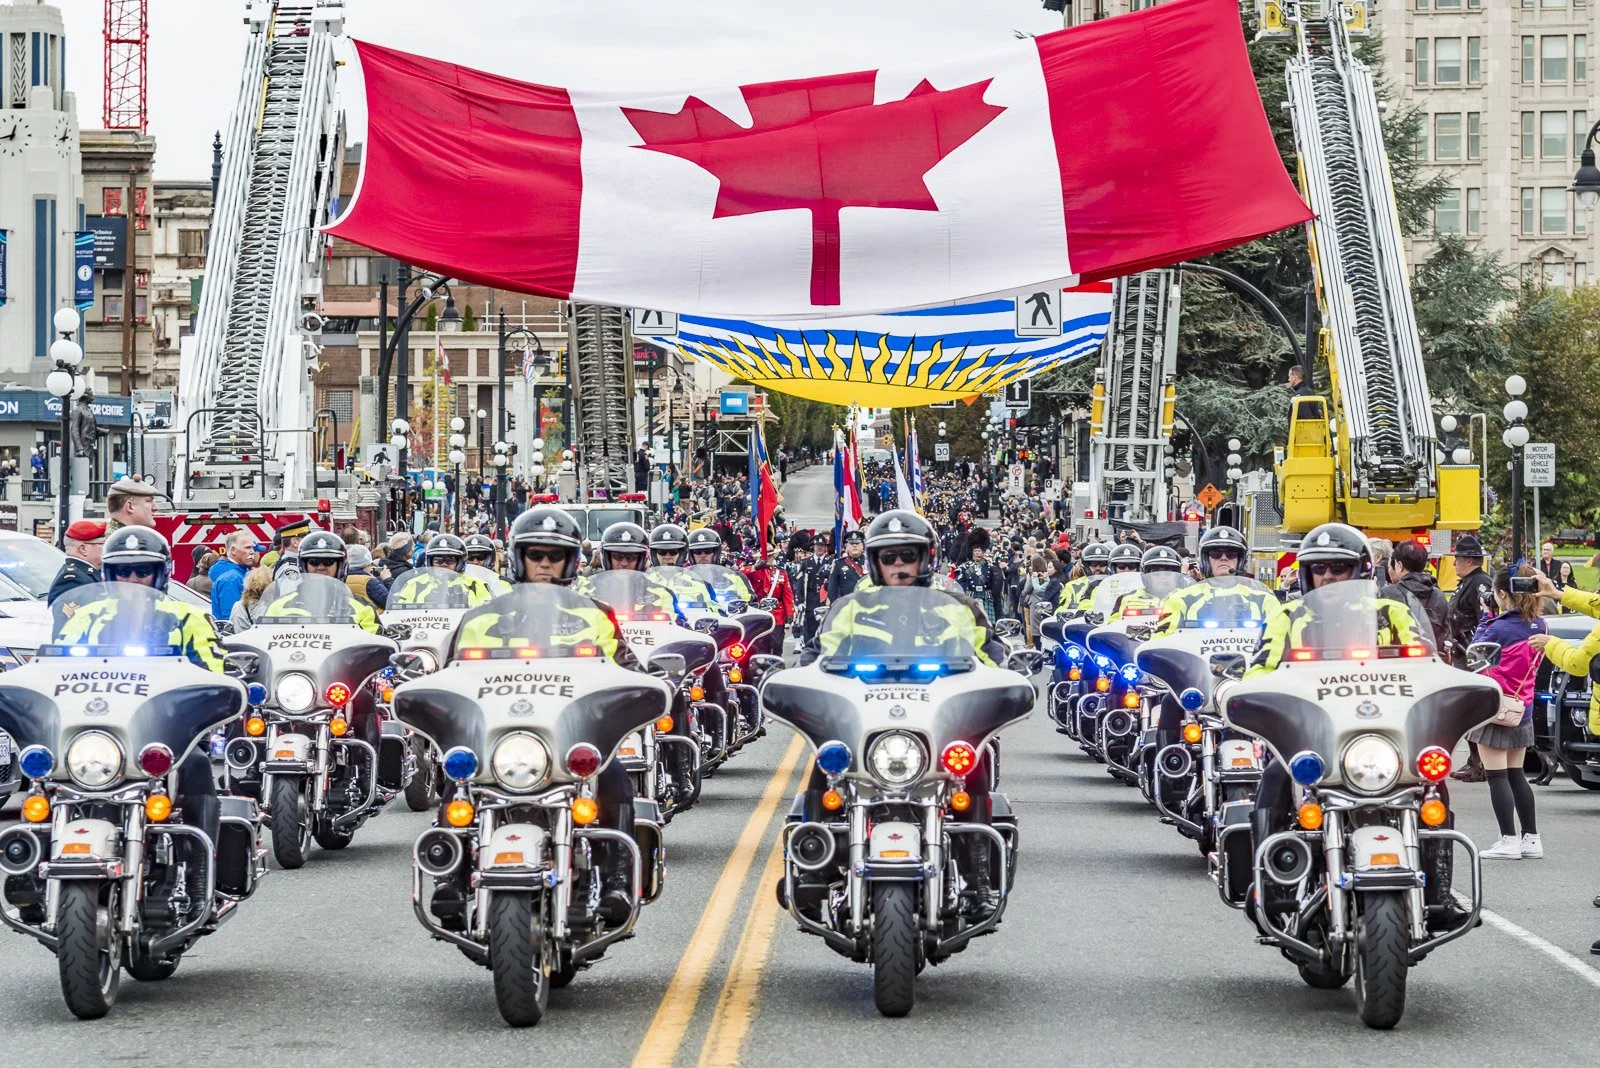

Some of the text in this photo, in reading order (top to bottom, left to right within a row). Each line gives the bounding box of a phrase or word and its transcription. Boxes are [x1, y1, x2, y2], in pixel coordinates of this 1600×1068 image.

[102, 404, 124, 416] CENTRE
[936, 447, 949, 456] 30
[410, 622, 451, 630] OLICE
[272, 632, 331, 641] VANCOUVER
[1202, 637, 1256, 645] VANCOUVE
[267, 640, 333, 651] POLICE
[1200, 645, 1254, 655] POLIC
[61, 671, 147, 681] VANCOUVER
[484, 673, 571, 684] VANCOUVER
[1319, 673, 1407, 685] VANCOUVER
[54, 682, 149, 697] POLICE
[477, 684, 575, 699] POLICE
[1316, 684, 1415, 701] POLICE
[864, 692, 930, 702] POLICE
